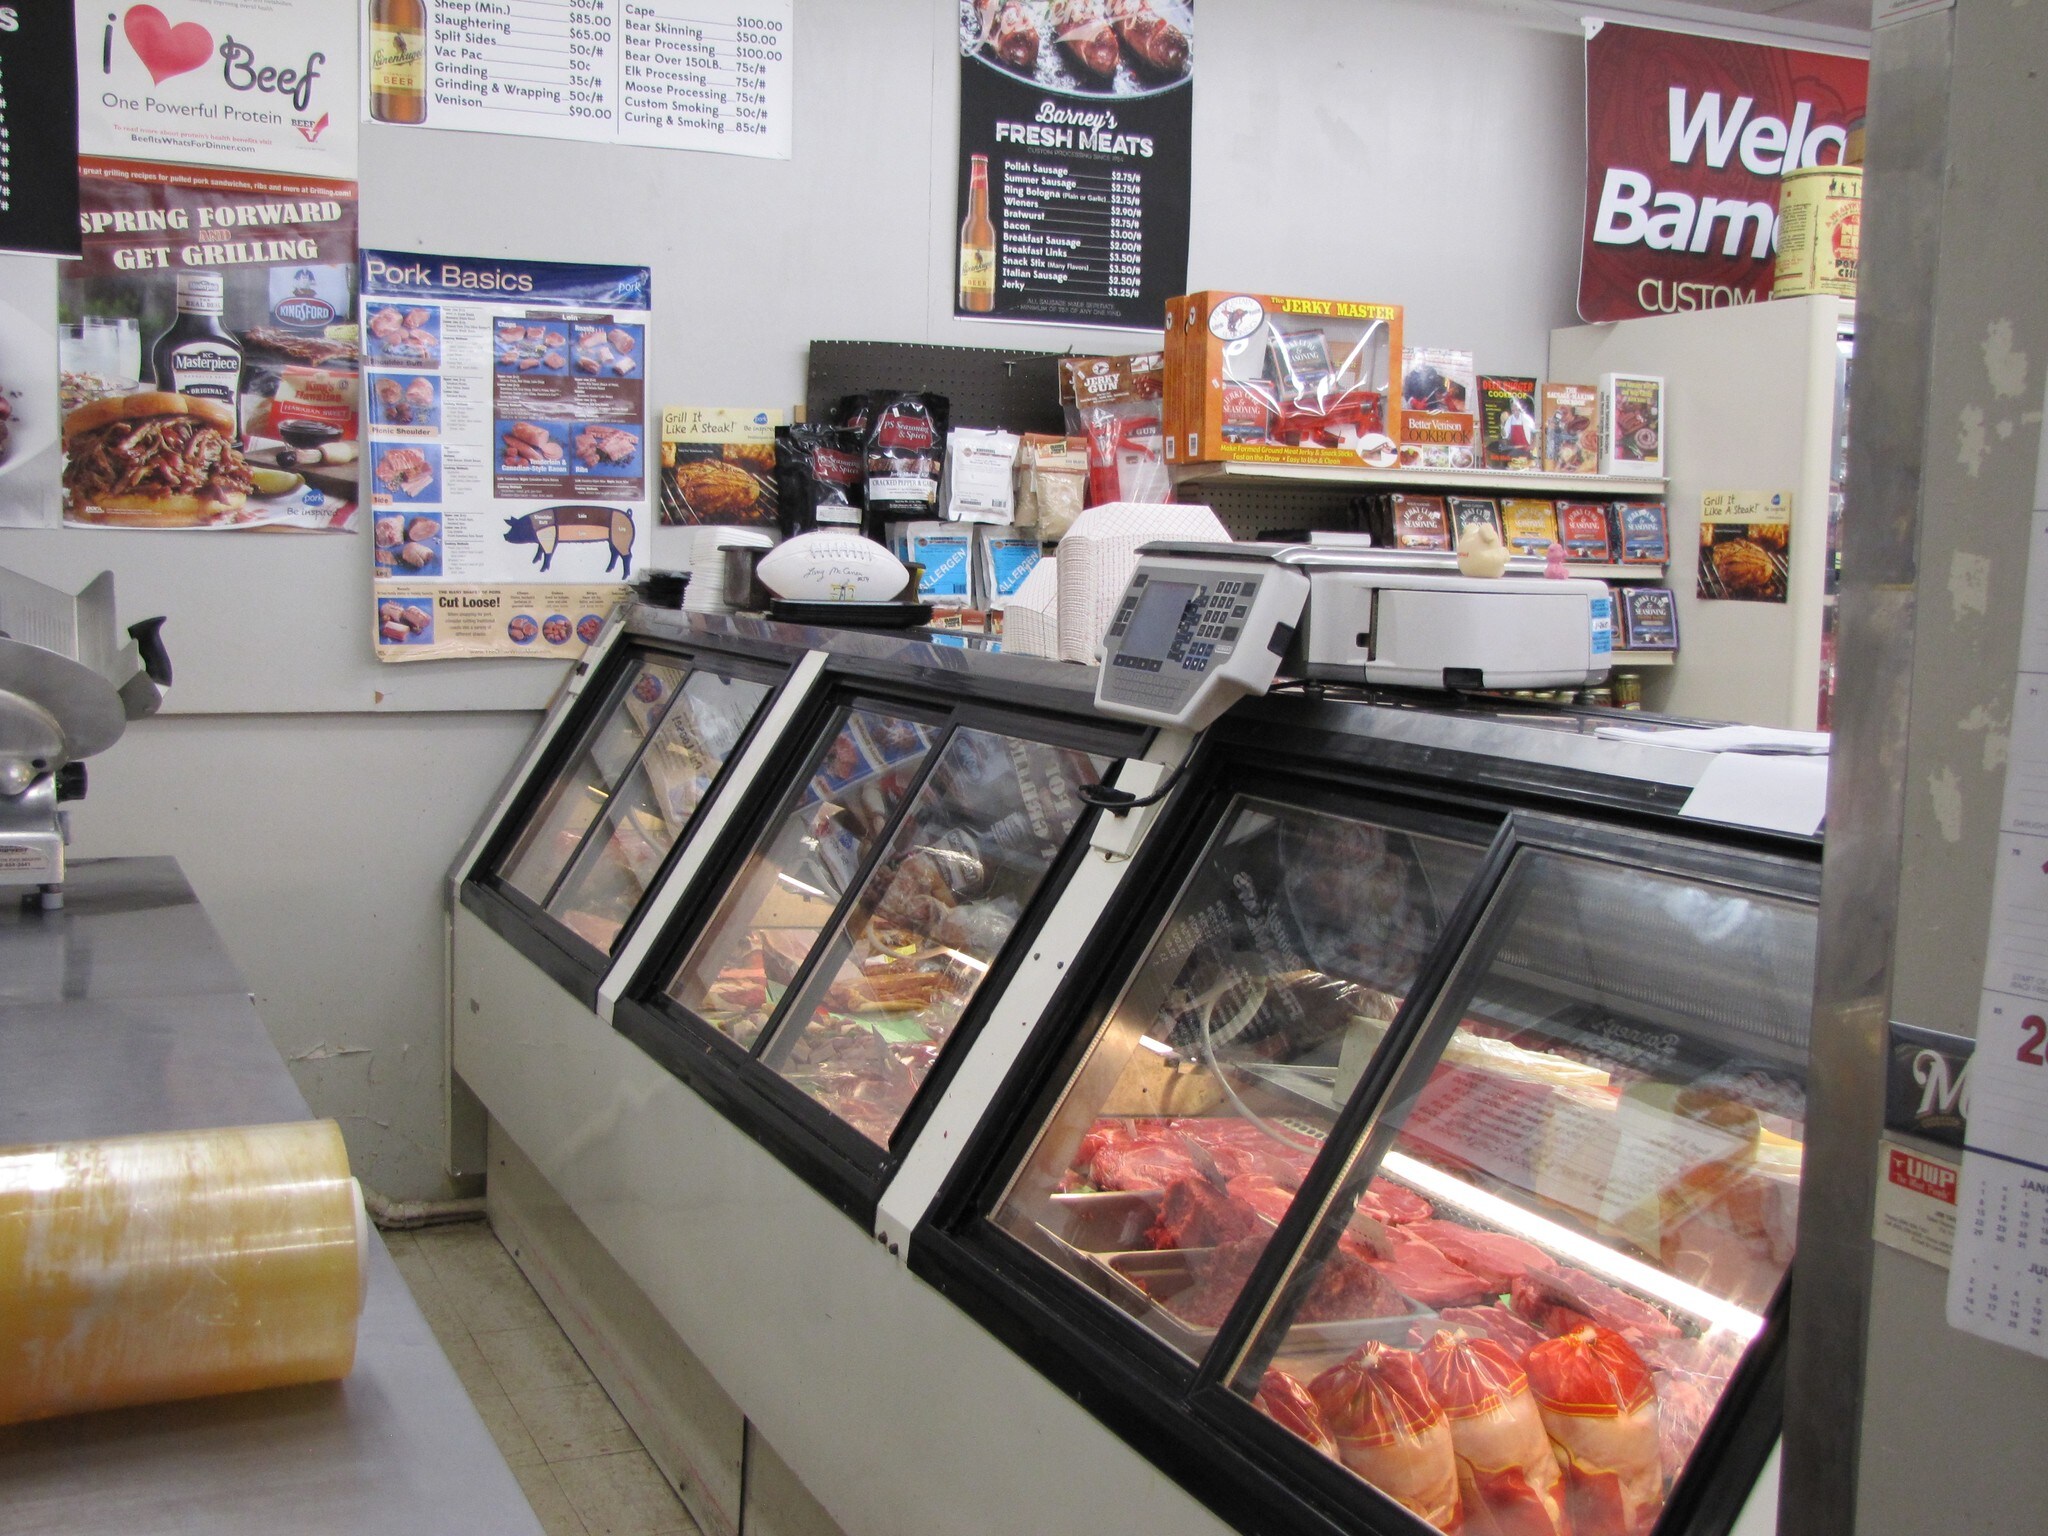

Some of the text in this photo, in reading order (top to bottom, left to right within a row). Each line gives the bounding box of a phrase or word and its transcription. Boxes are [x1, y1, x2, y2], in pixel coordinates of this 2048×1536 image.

[435, 0, 612, 27] Sheep (Min.) $85.00
[626, 4, 783, 32] Cape $100.00
[435, 14, 611, 42] Slaughtering $65.00
[435, 29, 461, 45] Split
[465, 32, 497, 46] Sides
[625, 19, 776, 46] Bear Skinning $50.00
[435, 45, 457, 58] Vac
[461, 48, 484, 61] Pac
[625, 34, 783, 62] Bear Processing $100.00
[103, 13, 326, 111] i Beef
[625, 50, 651, 62] Bear
[655, 54, 682, 66] Over
[686, 57, 722, 71] 150LB.
[435, 62, 488, 81] Grinding
[625, 65, 642, 76] Elk
[646, 67, 707, 88] Processing
[435, 78, 488, 96] Grinding
[492, 83, 500, 94] &
[504, 84, 562, 104] Wrapping
[625, 80, 662, 94] Moose
[667, 85, 727, 105] Processing
[102, 92, 283, 126] One Powerful Protein
[435, 93, 613, 120] Venison $90.00
[625, 96, 668, 111] Custom
[672, 101, 720, 119] Smoking
[625, 112, 662, 128] Curing
[666, 115, 674, 126] &
[678, 116, 725, 135] Smoking
[1035, 101, 1119, 134] Barney's
[996, 121, 1154, 158] FRESH MEATS
[1668, 86, 1847, 175] Welc
[104, 168, 130, 180] grilling
[131, 170, 158, 182] recipes
[1004, 162, 1031, 174] Polish
[1032, 164, 1068, 178] Sausage
[1004, 174, 1038, 186] Summer
[1041, 176, 1077, 190] Sausage
[1004, 185, 1024, 198] Ring
[1026, 187, 1060, 201] Bologna
[1004, 197, 1039, 209] Wieners
[80, 201, 343, 235] SPRING FORWARD
[1004, 209, 1046, 221] Bratwurst
[1593, 168, 1779, 260] Barn
[1004, 220, 1031, 232] Bacon
[1003, 232, 1043, 245] Breakfast
[1046, 236, 1081, 250] Sausage
[113, 239, 319, 271] GET GRILLING
[1003, 244, 1042, 256] Breakfast
[1044, 246, 1068, 259] Links
[1002, 256, 1028, 268] Snack
[1030, 258, 1046, 269] Stix
[367, 260, 534, 292] Pork Basics
[1002, 268, 1031, 280] Italian
[1032, 270, 1068, 285] Sausage
[1002, 280, 1025, 292] Jerky
[279, 303, 330, 321] KINGSFORD
[1282, 298, 1333, 315] JERKY
[1336, 301, 1395, 320] MASTER
[176, 354, 239, 372] Masterpiece
[1084, 374, 1120, 387] JERKY
[1088, 382, 1118, 394] GUN
[665, 412, 702, 424] Grill It
[666, 420, 736, 434] Like A Steak!
[1408, 420, 1462, 432] Better Venison
[882, 421, 930, 436] PS Seasoning
[905, 432, 928, 442] Spices
[1704, 494, 1735, 506] Grill It
[1704, 503, 1760, 516] Like A Steak!
[919, 547, 967, 591] ALLERGEN
[999, 551, 1040, 593] ALLERGEN
[438, 596, 460, 608] Cut
[462, 596, 500, 608] Loose!
[2016, 1013, 2048, 1067] 2
[1906, 1157, 1956, 1188] UWP
